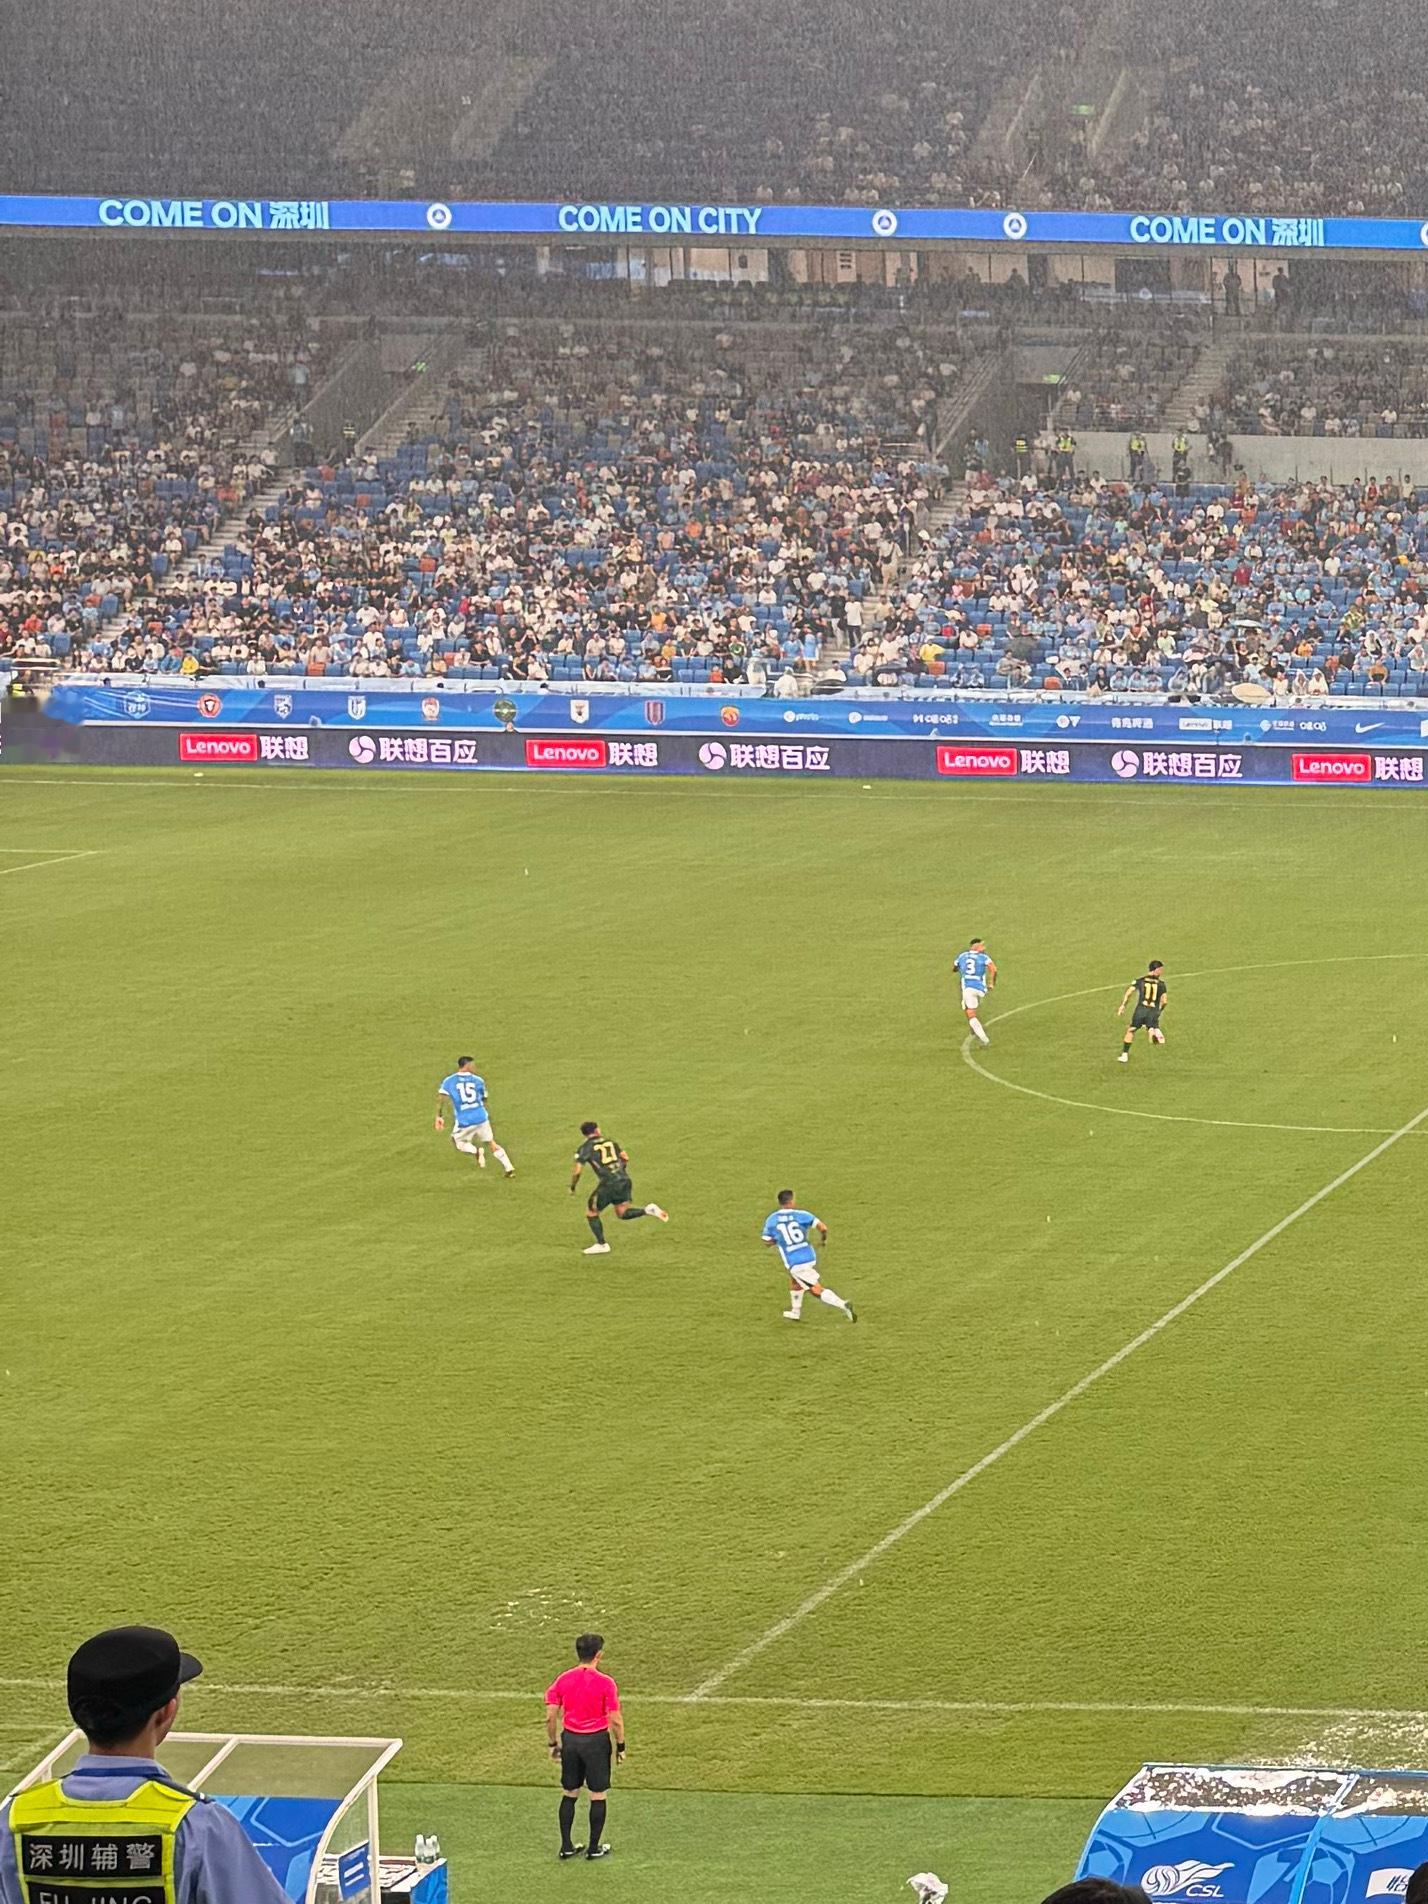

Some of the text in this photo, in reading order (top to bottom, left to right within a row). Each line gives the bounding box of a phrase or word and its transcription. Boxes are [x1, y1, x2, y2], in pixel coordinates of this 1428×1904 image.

[99, 199, 330, 229] COME ON 深圳
[558, 205, 762, 234] COME ON CITY
[1129, 216, 1324, 248] COME ON 深圳
[185, 735, 309, 760] Lenovo 联想
[379, 737, 478, 764] 联想百应
[533, 742, 658, 766] Lenovo 联想
[729, 744, 830, 771] 联想百应
[944, 750, 1071, 774] Lenovo 联想
[1142, 752, 1243, 779] 联想百应
[1299, 756, 1424, 781] Lenovo 联想
[965, 958, 976, 975] 3
[1144, 982, 1158, 1001] 11
[455, 1082, 477, 1103] 15
[776, 1221, 804, 1246] 16
[29, 1842, 156, 1872] 深圳辅警
[1185, 1884, 1225, 1898] CSL
